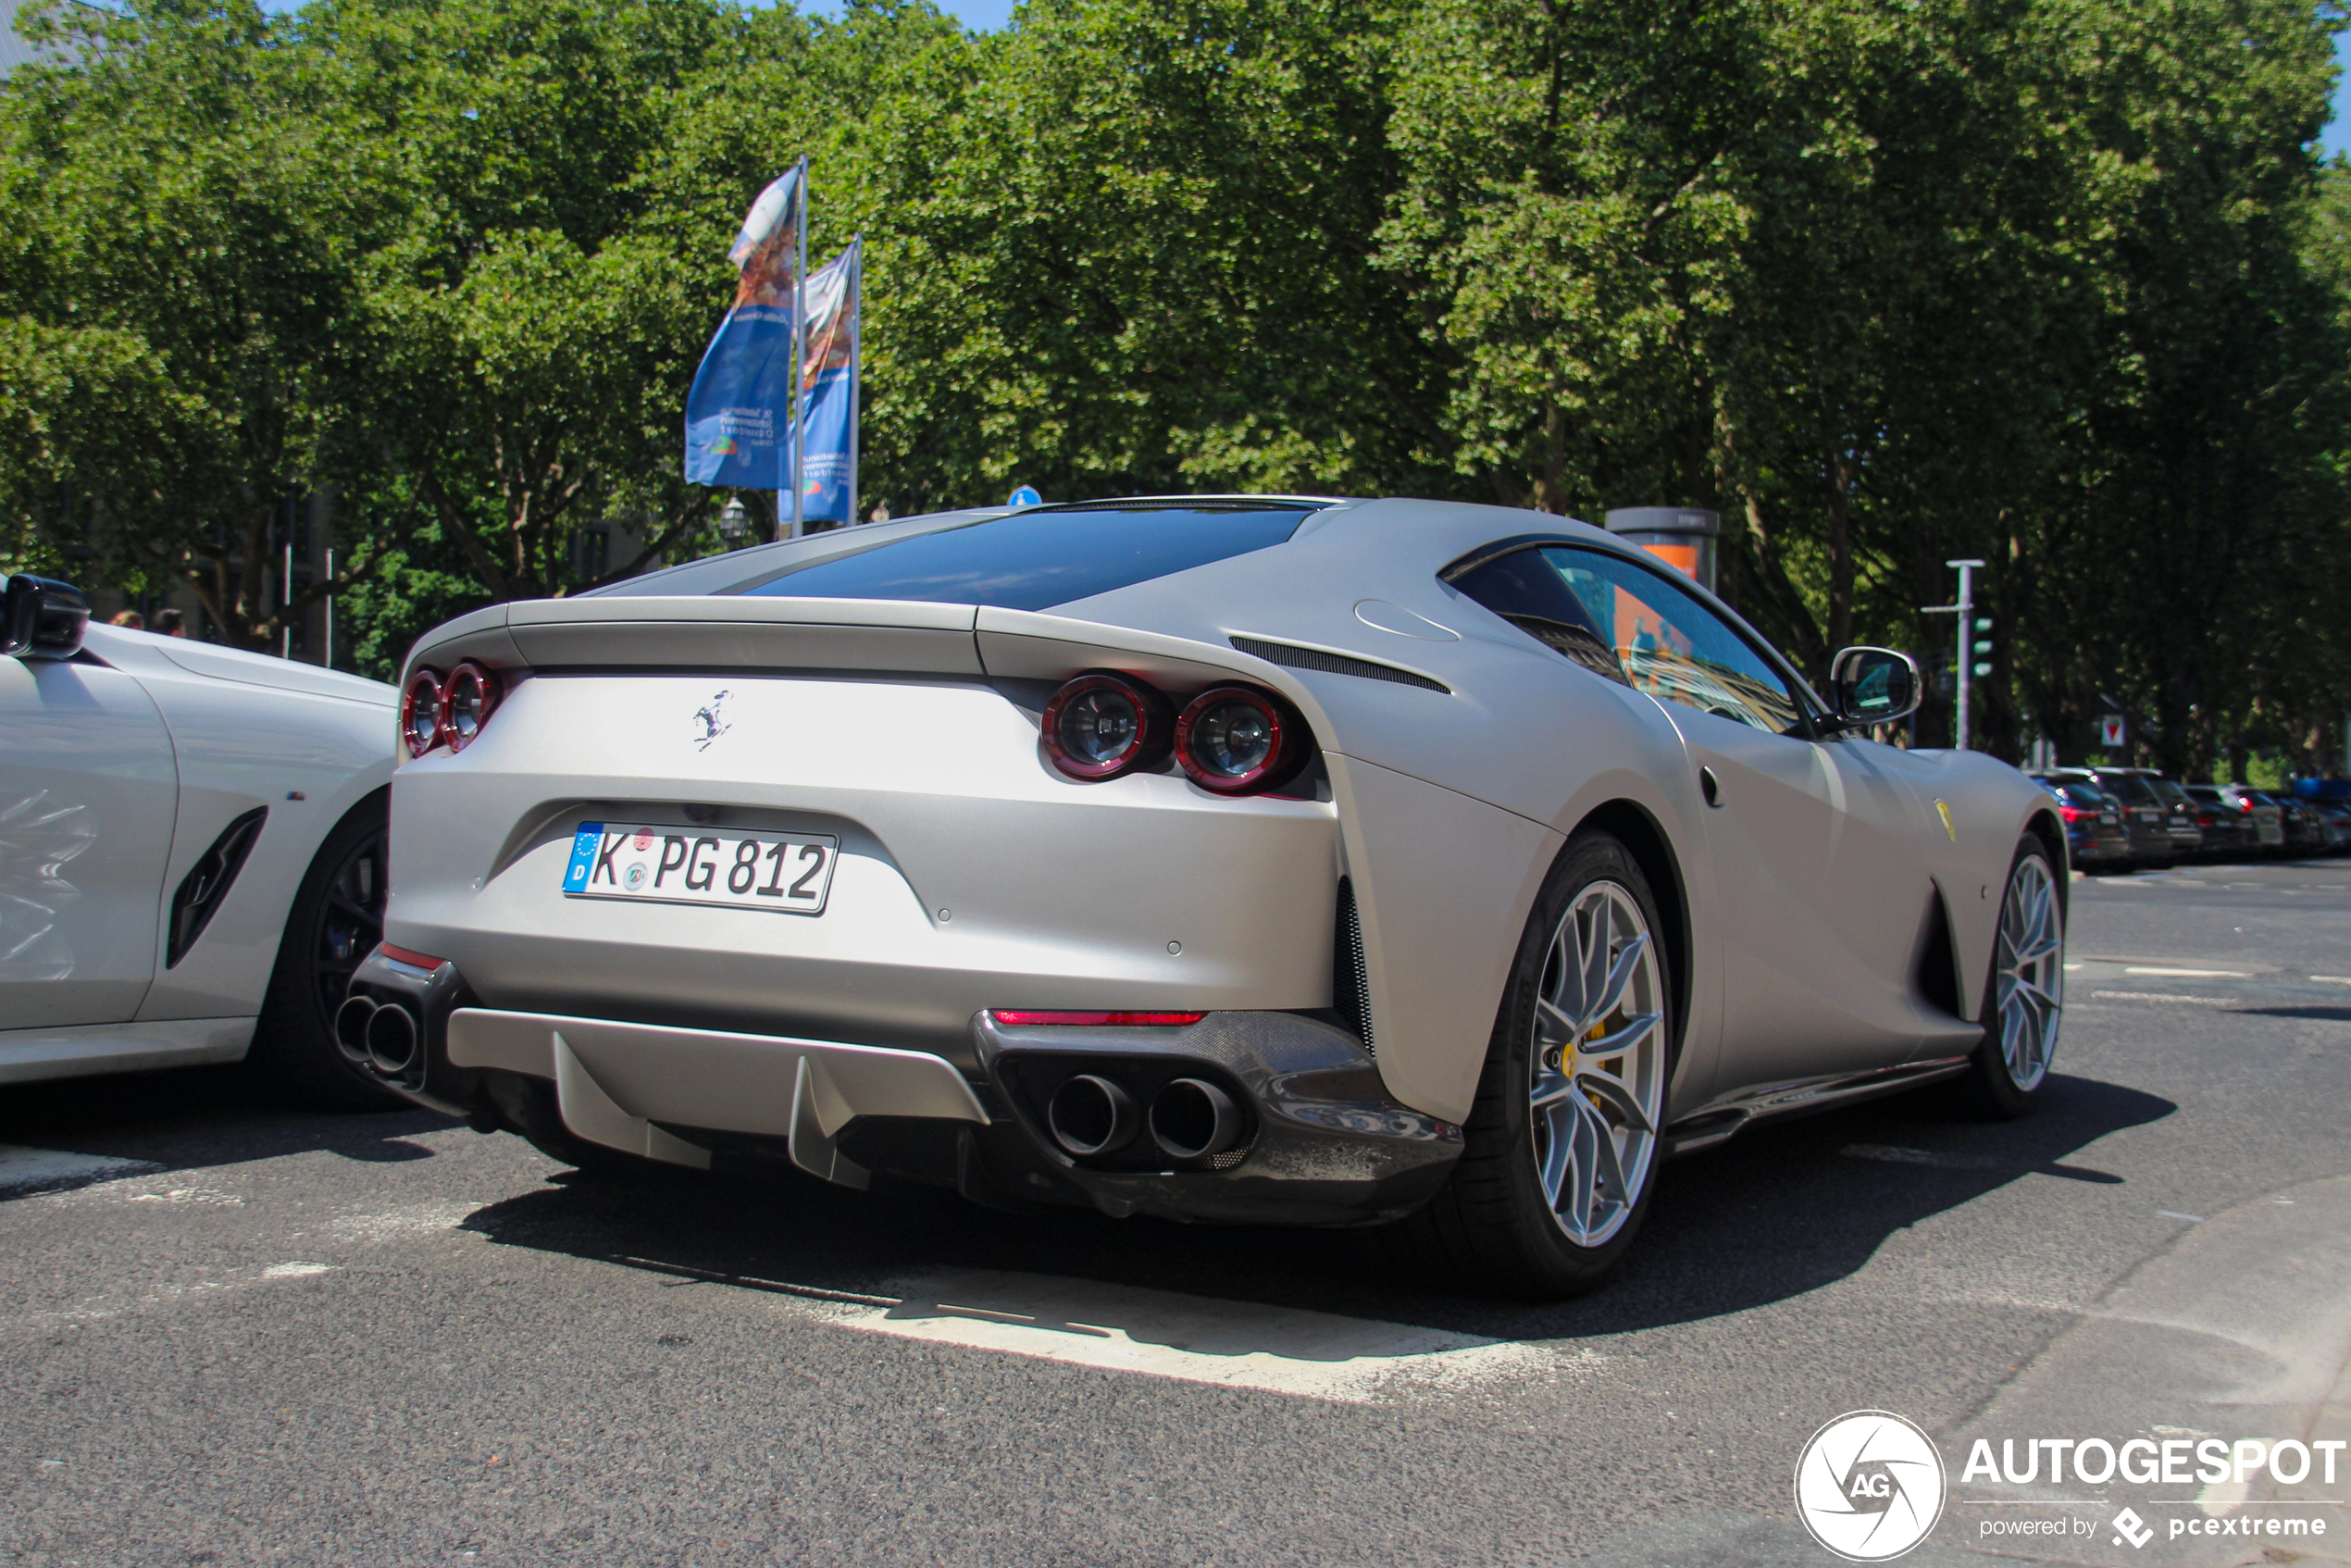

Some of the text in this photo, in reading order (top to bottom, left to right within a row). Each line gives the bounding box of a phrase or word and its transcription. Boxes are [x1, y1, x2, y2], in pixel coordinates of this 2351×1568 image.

[572, 865, 586, 880] D
[592, 832, 826, 900] K PG 812
